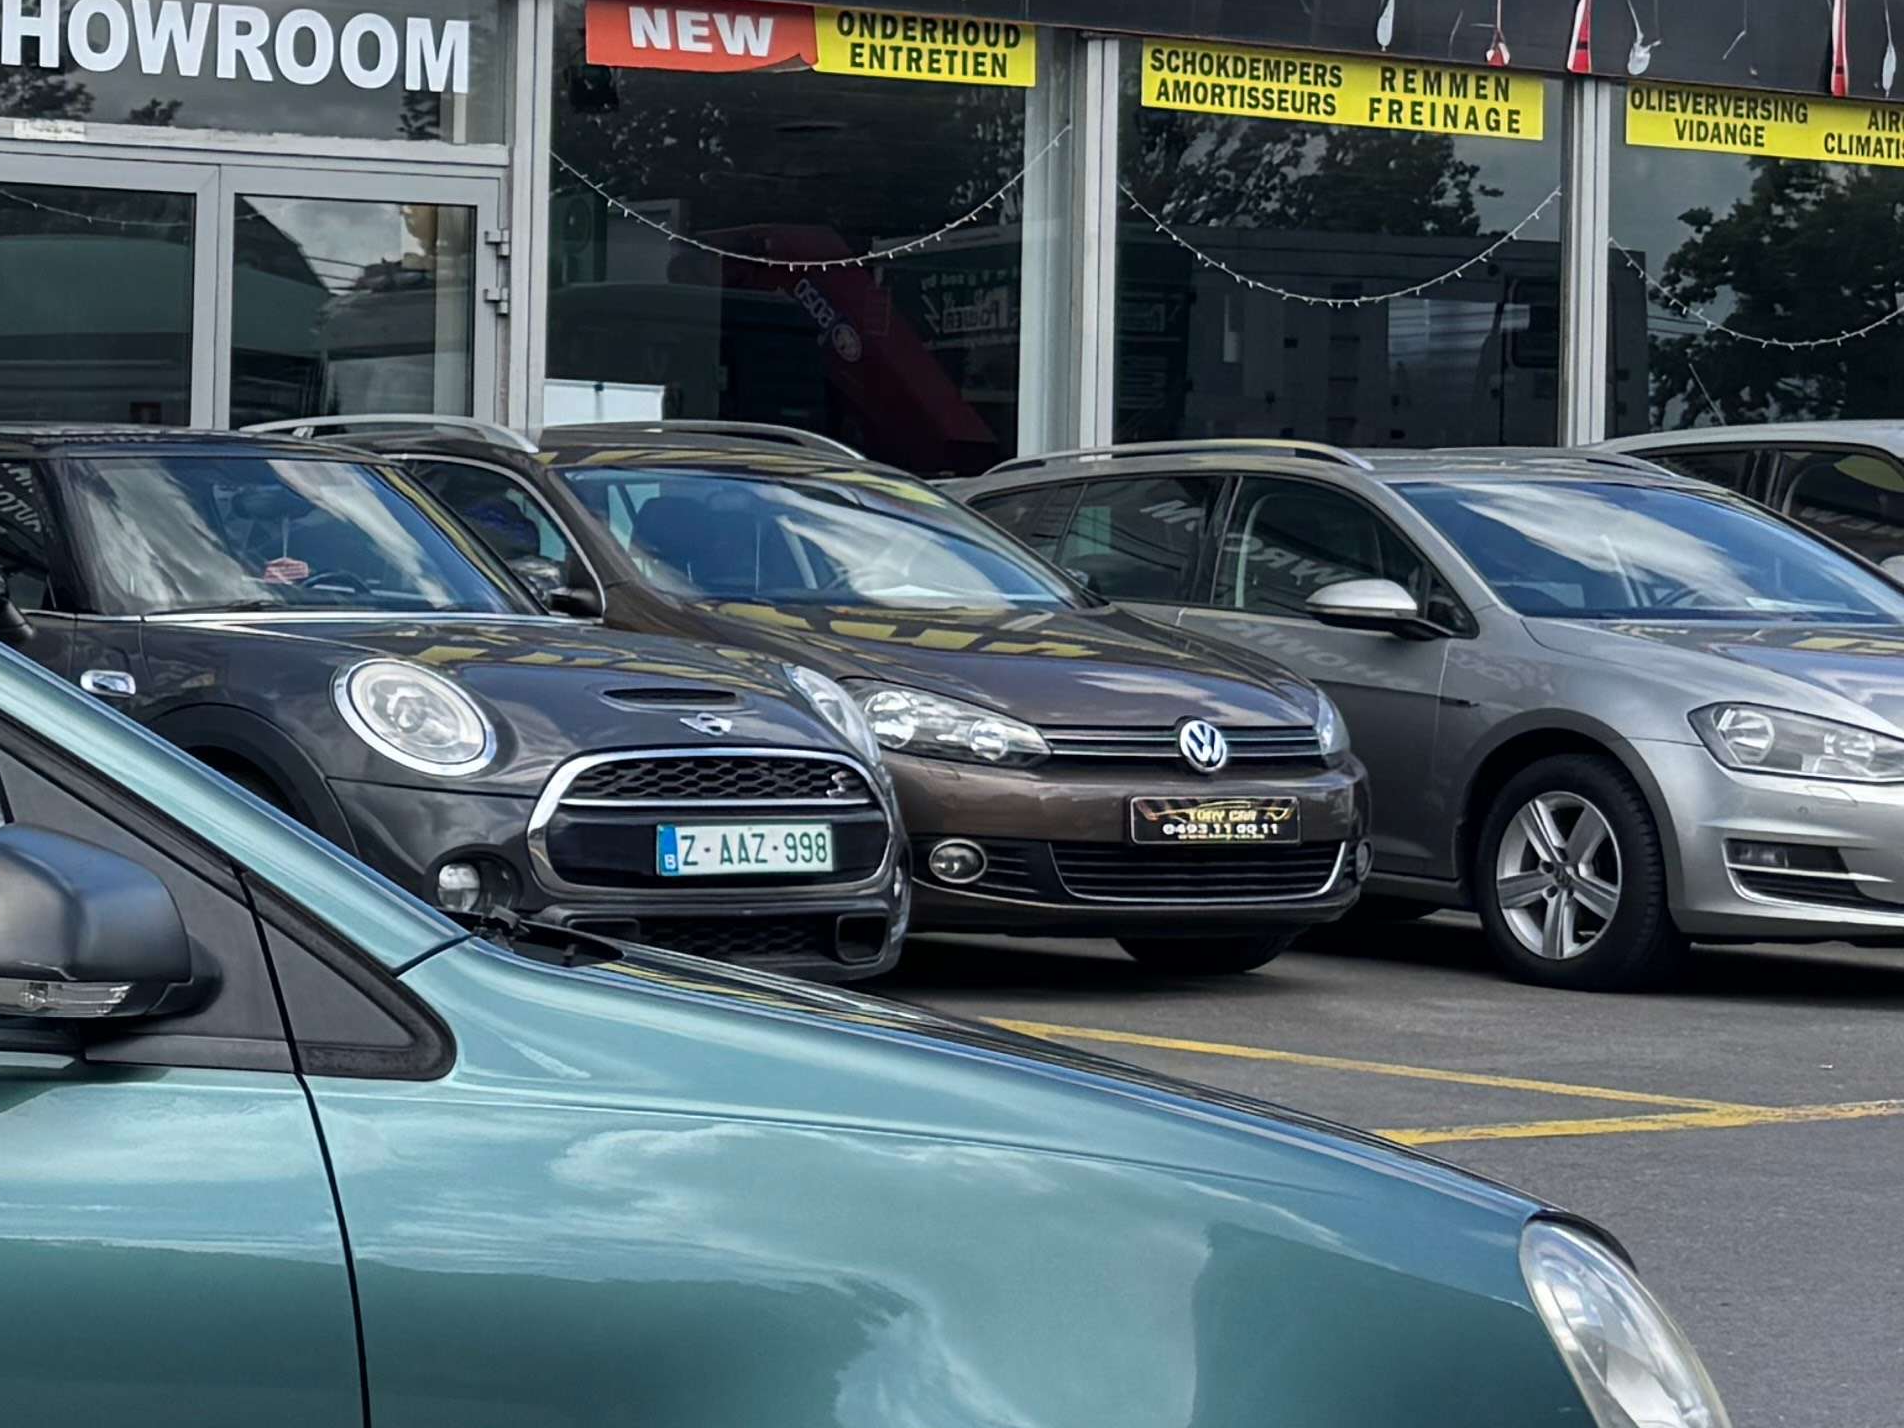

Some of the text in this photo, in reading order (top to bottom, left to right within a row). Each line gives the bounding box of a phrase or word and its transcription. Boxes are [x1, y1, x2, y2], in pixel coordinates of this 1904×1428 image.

[629, 7, 773, 57] NEW
[837, 10, 1021, 50] ONDERHOUD
[849, 43, 1008, 79] ENTRETIEN
[1150, 48, 1343, 88] SCHOKDEMPERS
[1156, 78, 1337, 116] AMORTISSEURS
[1380, 66, 1511, 102] REMMEN
[1369, 97, 1522, 134] FREINAGE
[1630, 87, 1809, 125] OLIEVERVERSING
[1867, 109, 1904, 133] AIR
[1674, 118, 1766, 148] VIDANGE
[1823, 132, 1904, 160] CLIMATI
[664, 854, 677, 871] B
